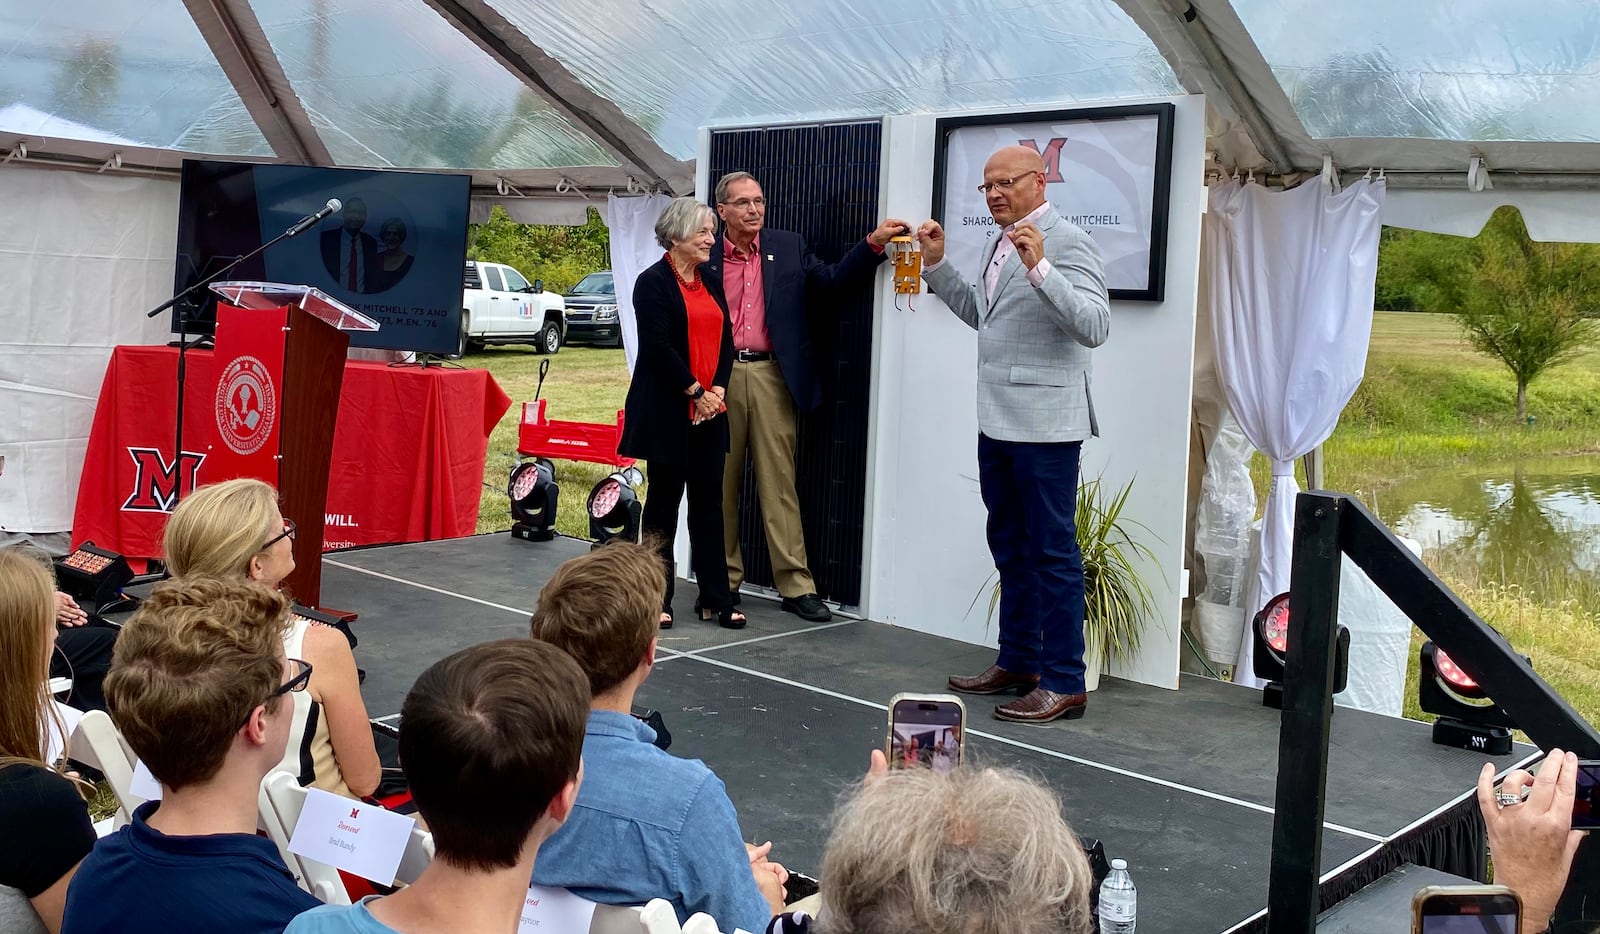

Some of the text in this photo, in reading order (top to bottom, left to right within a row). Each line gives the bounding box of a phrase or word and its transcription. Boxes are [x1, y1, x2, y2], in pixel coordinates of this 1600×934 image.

[1018, 137, 1068, 183] M
[962, 216, 997, 226] SHARO
[1071, 215, 1121, 225] MITCHELL
[363, 303, 408, 314] MITCHELL
[427, 308, 448, 317] AND
[120, 446, 207, 514] M
[324, 513, 359, 527] WILL.
[1471, 735, 1487, 748] NY
